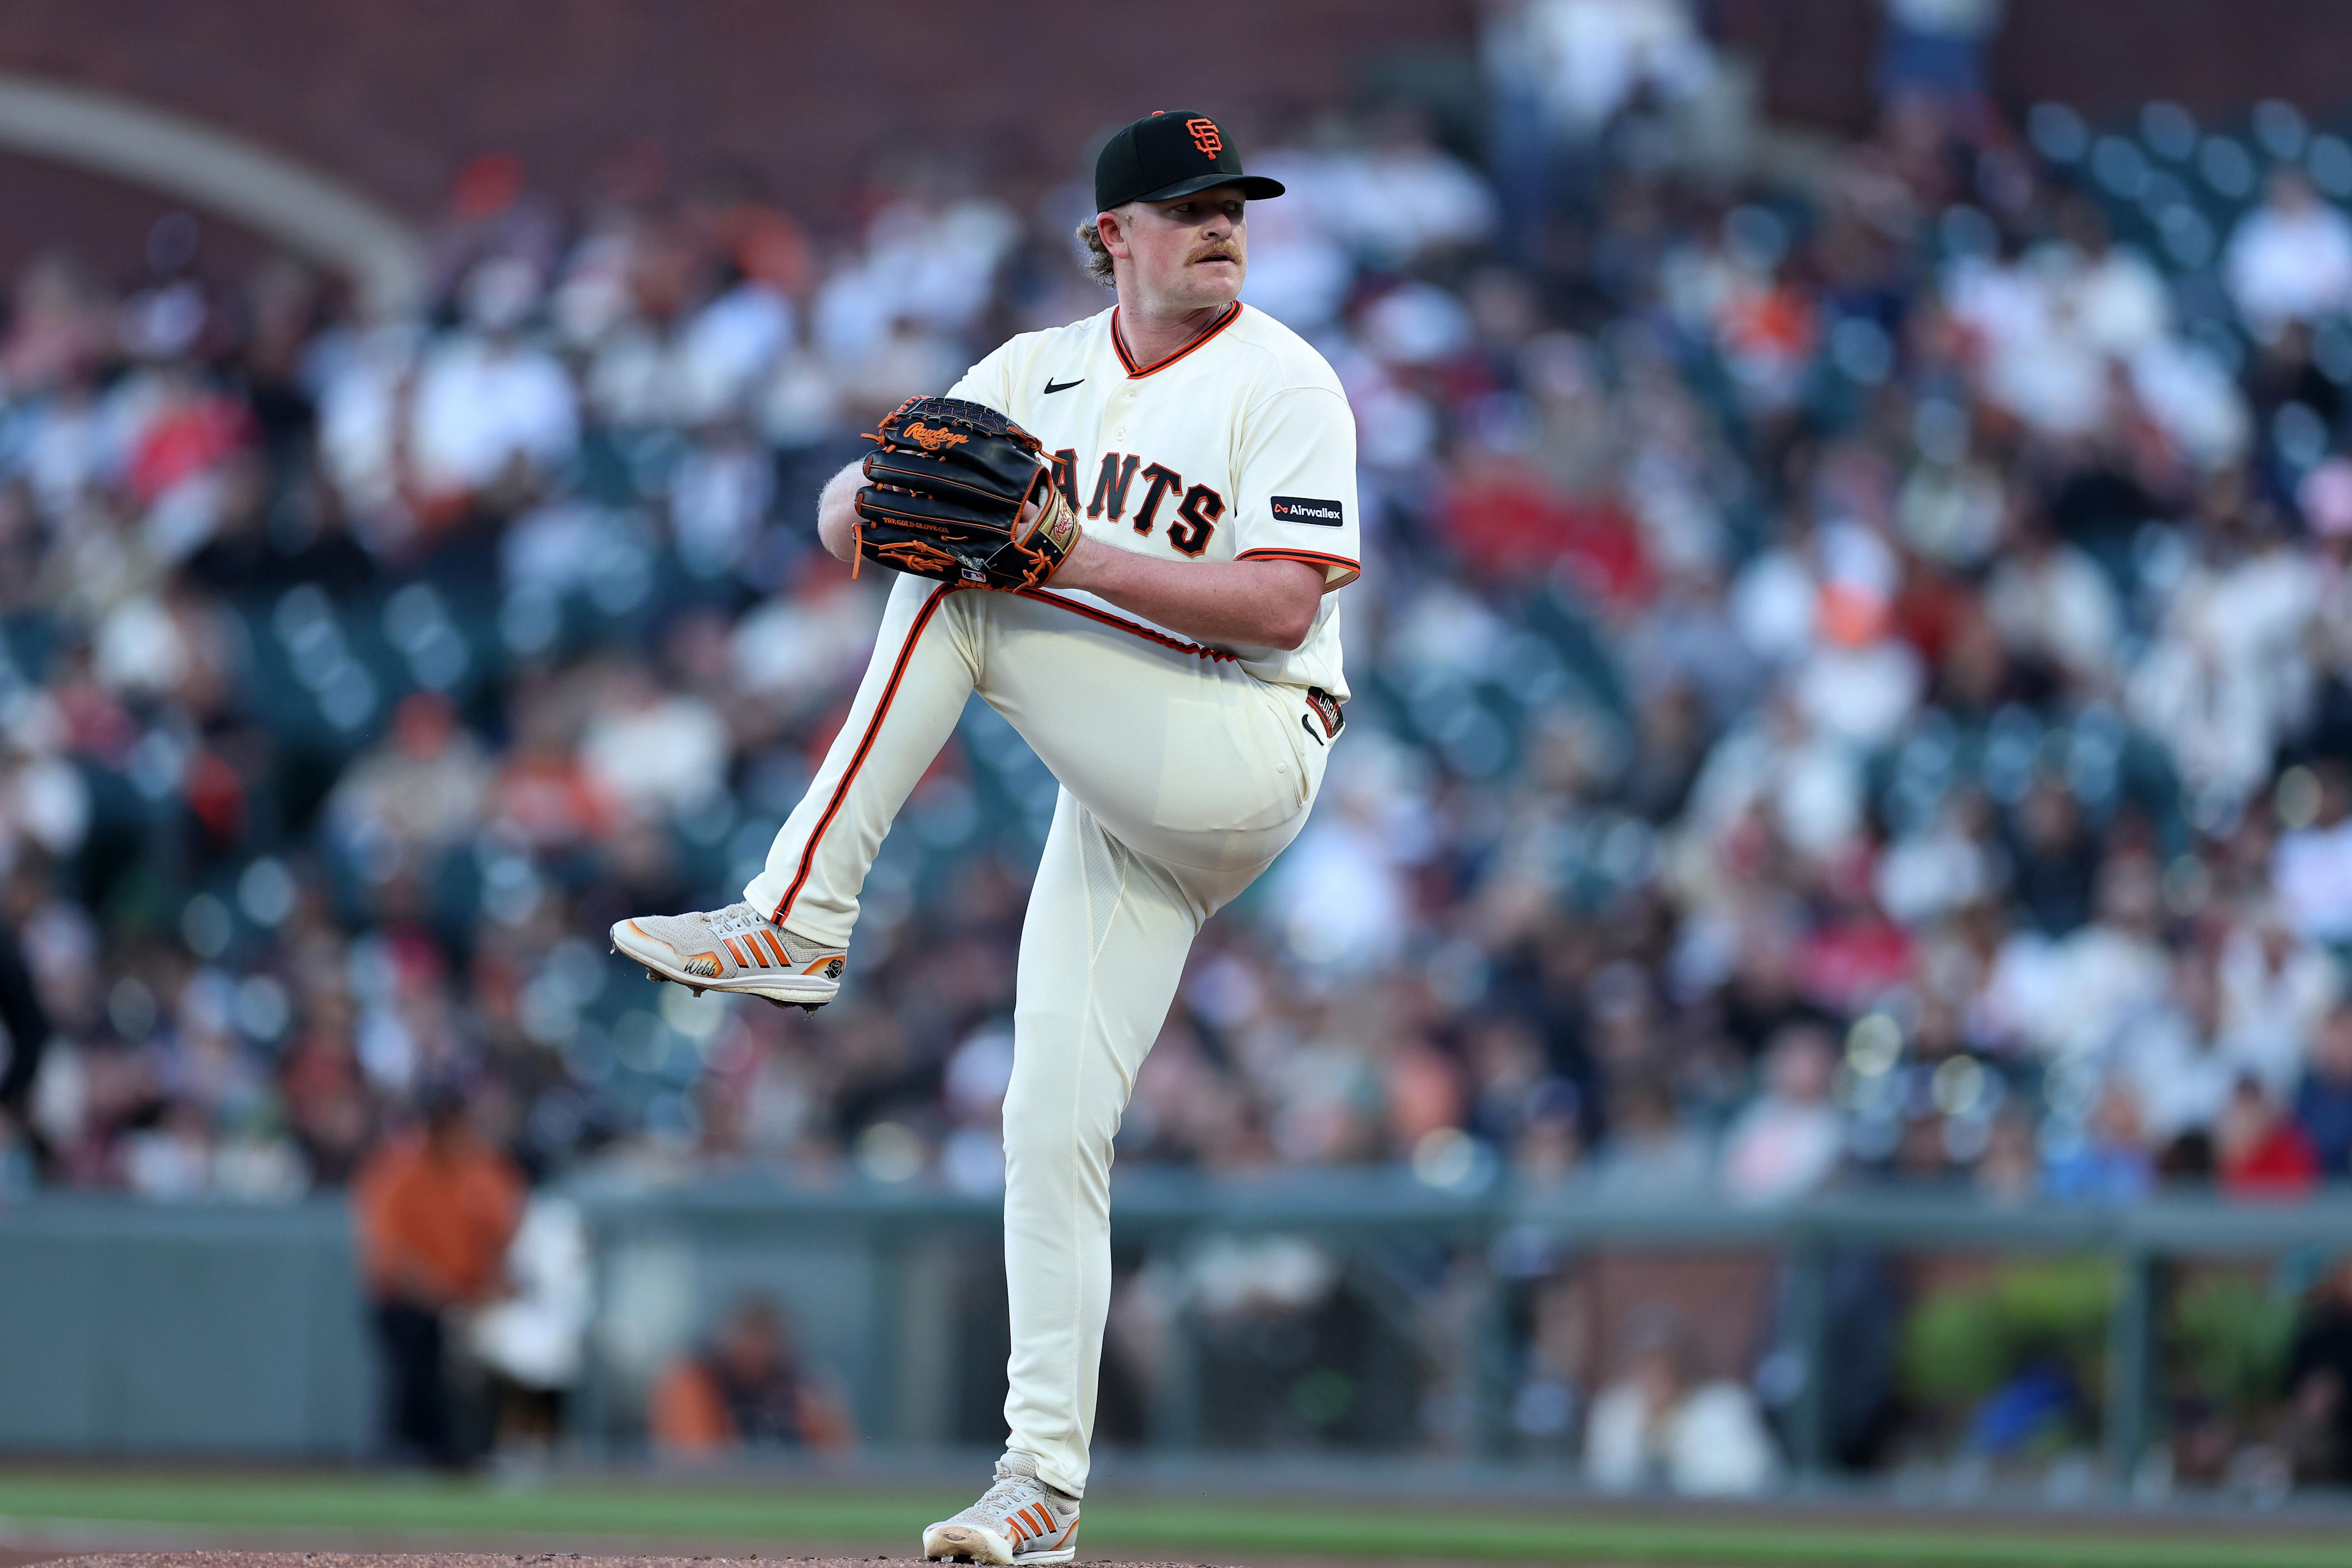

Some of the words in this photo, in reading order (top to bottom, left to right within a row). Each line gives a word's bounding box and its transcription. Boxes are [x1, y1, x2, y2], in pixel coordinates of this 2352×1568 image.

[1186, 118, 1222, 160] SF
[903, 422, 970, 450] Rawlings
[1038, 448, 1225, 557] ANTS
[1290, 504, 1340, 519] Airwallex
[915, 522, 938, 531] GLOVE
[1318, 692, 1339, 729] LOGAN
[683, 957, 717, 976] Webb
